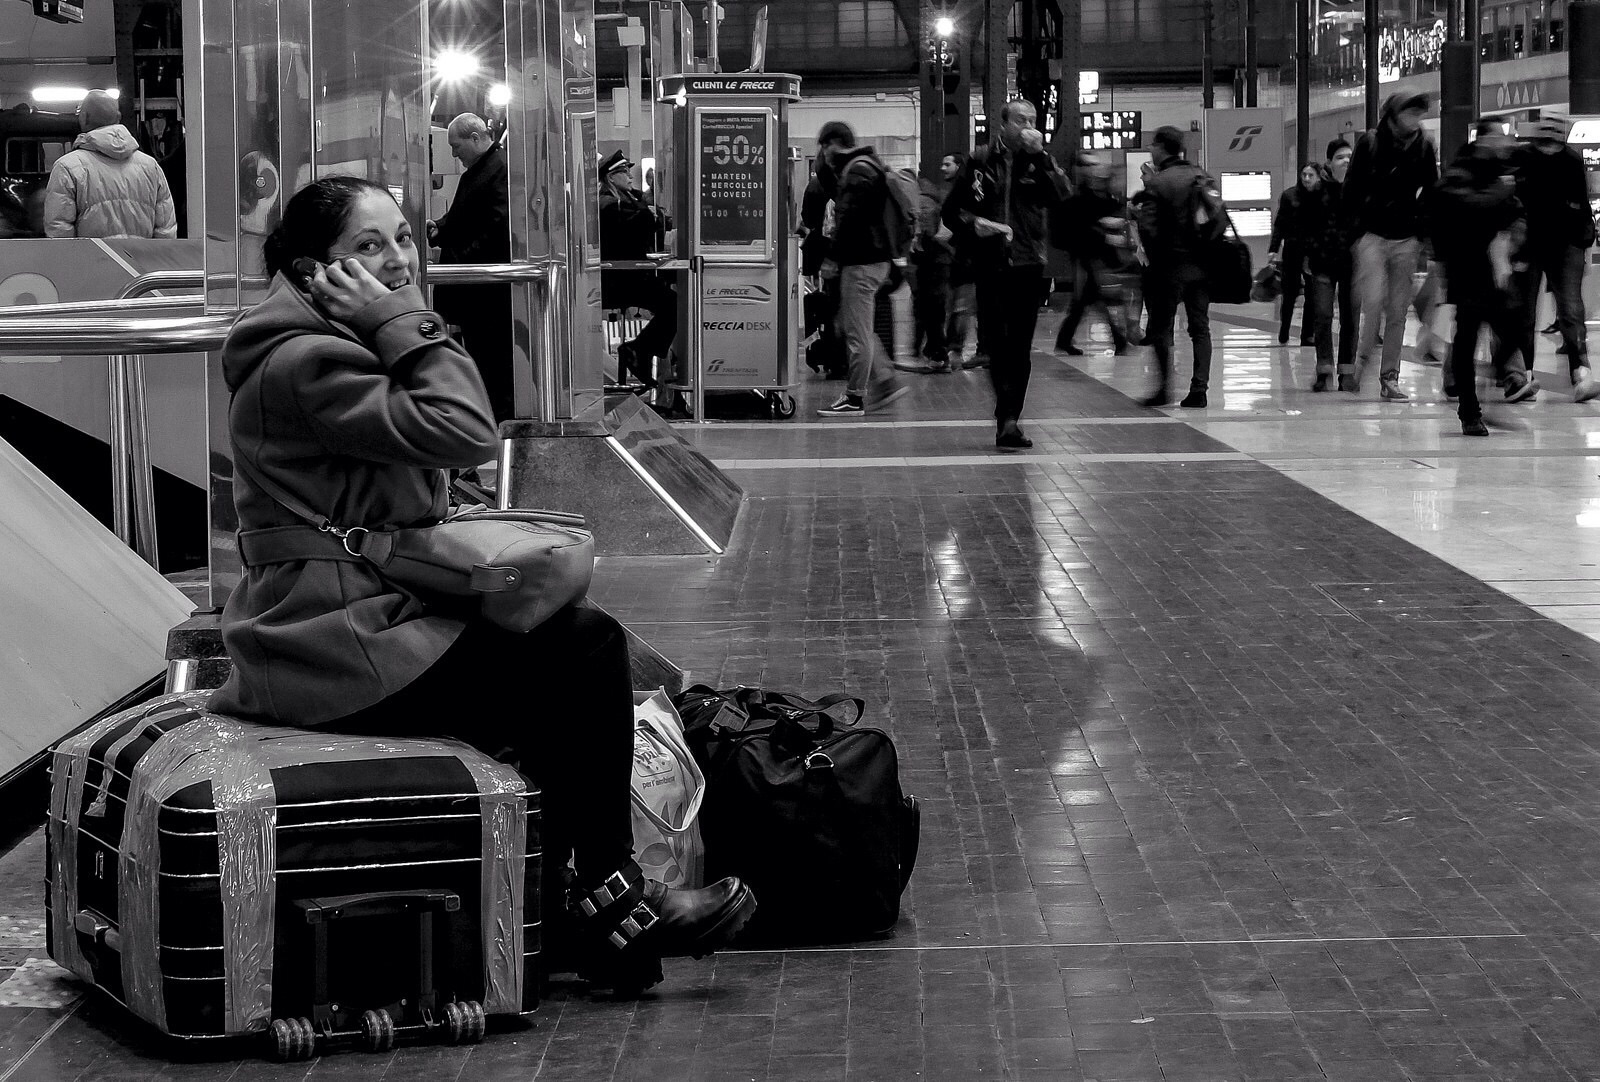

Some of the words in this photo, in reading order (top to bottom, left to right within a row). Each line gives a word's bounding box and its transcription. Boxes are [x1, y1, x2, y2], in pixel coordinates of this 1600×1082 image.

[692, 81, 723, 89] CLIENTI
[725, 81, 738, 90] LE
[739, 81, 775, 90] FRECCE
[703, 135, 764, 165] -50%
